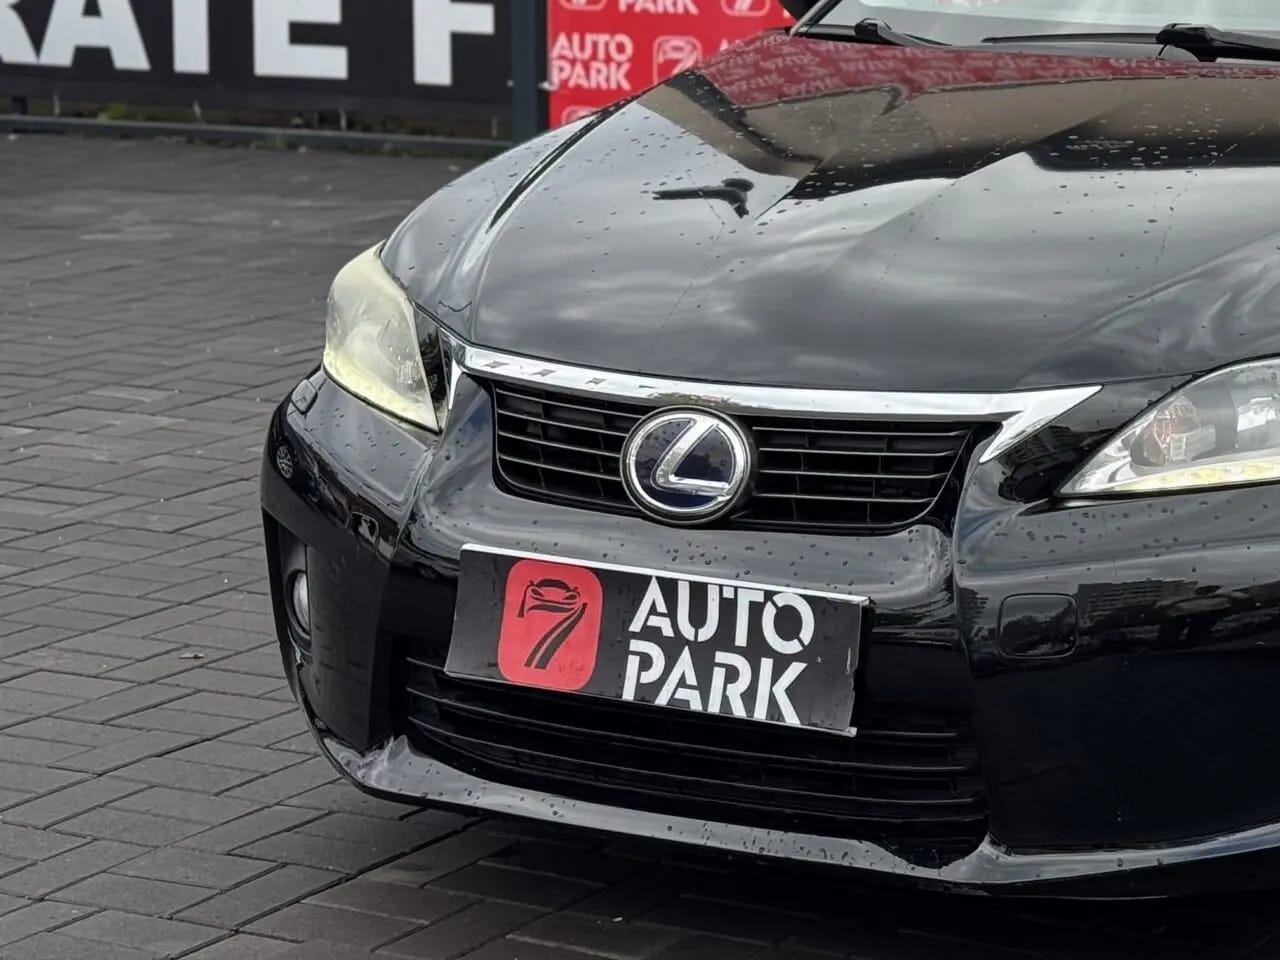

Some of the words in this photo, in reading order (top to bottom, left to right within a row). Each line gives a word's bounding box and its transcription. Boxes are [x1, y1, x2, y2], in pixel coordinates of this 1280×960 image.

[549, 32, 633, 63] AUTO
[549, 58, 631, 91] PARK
[627, 574, 816, 655] AUTO
[621, 640, 809, 726] PARK
